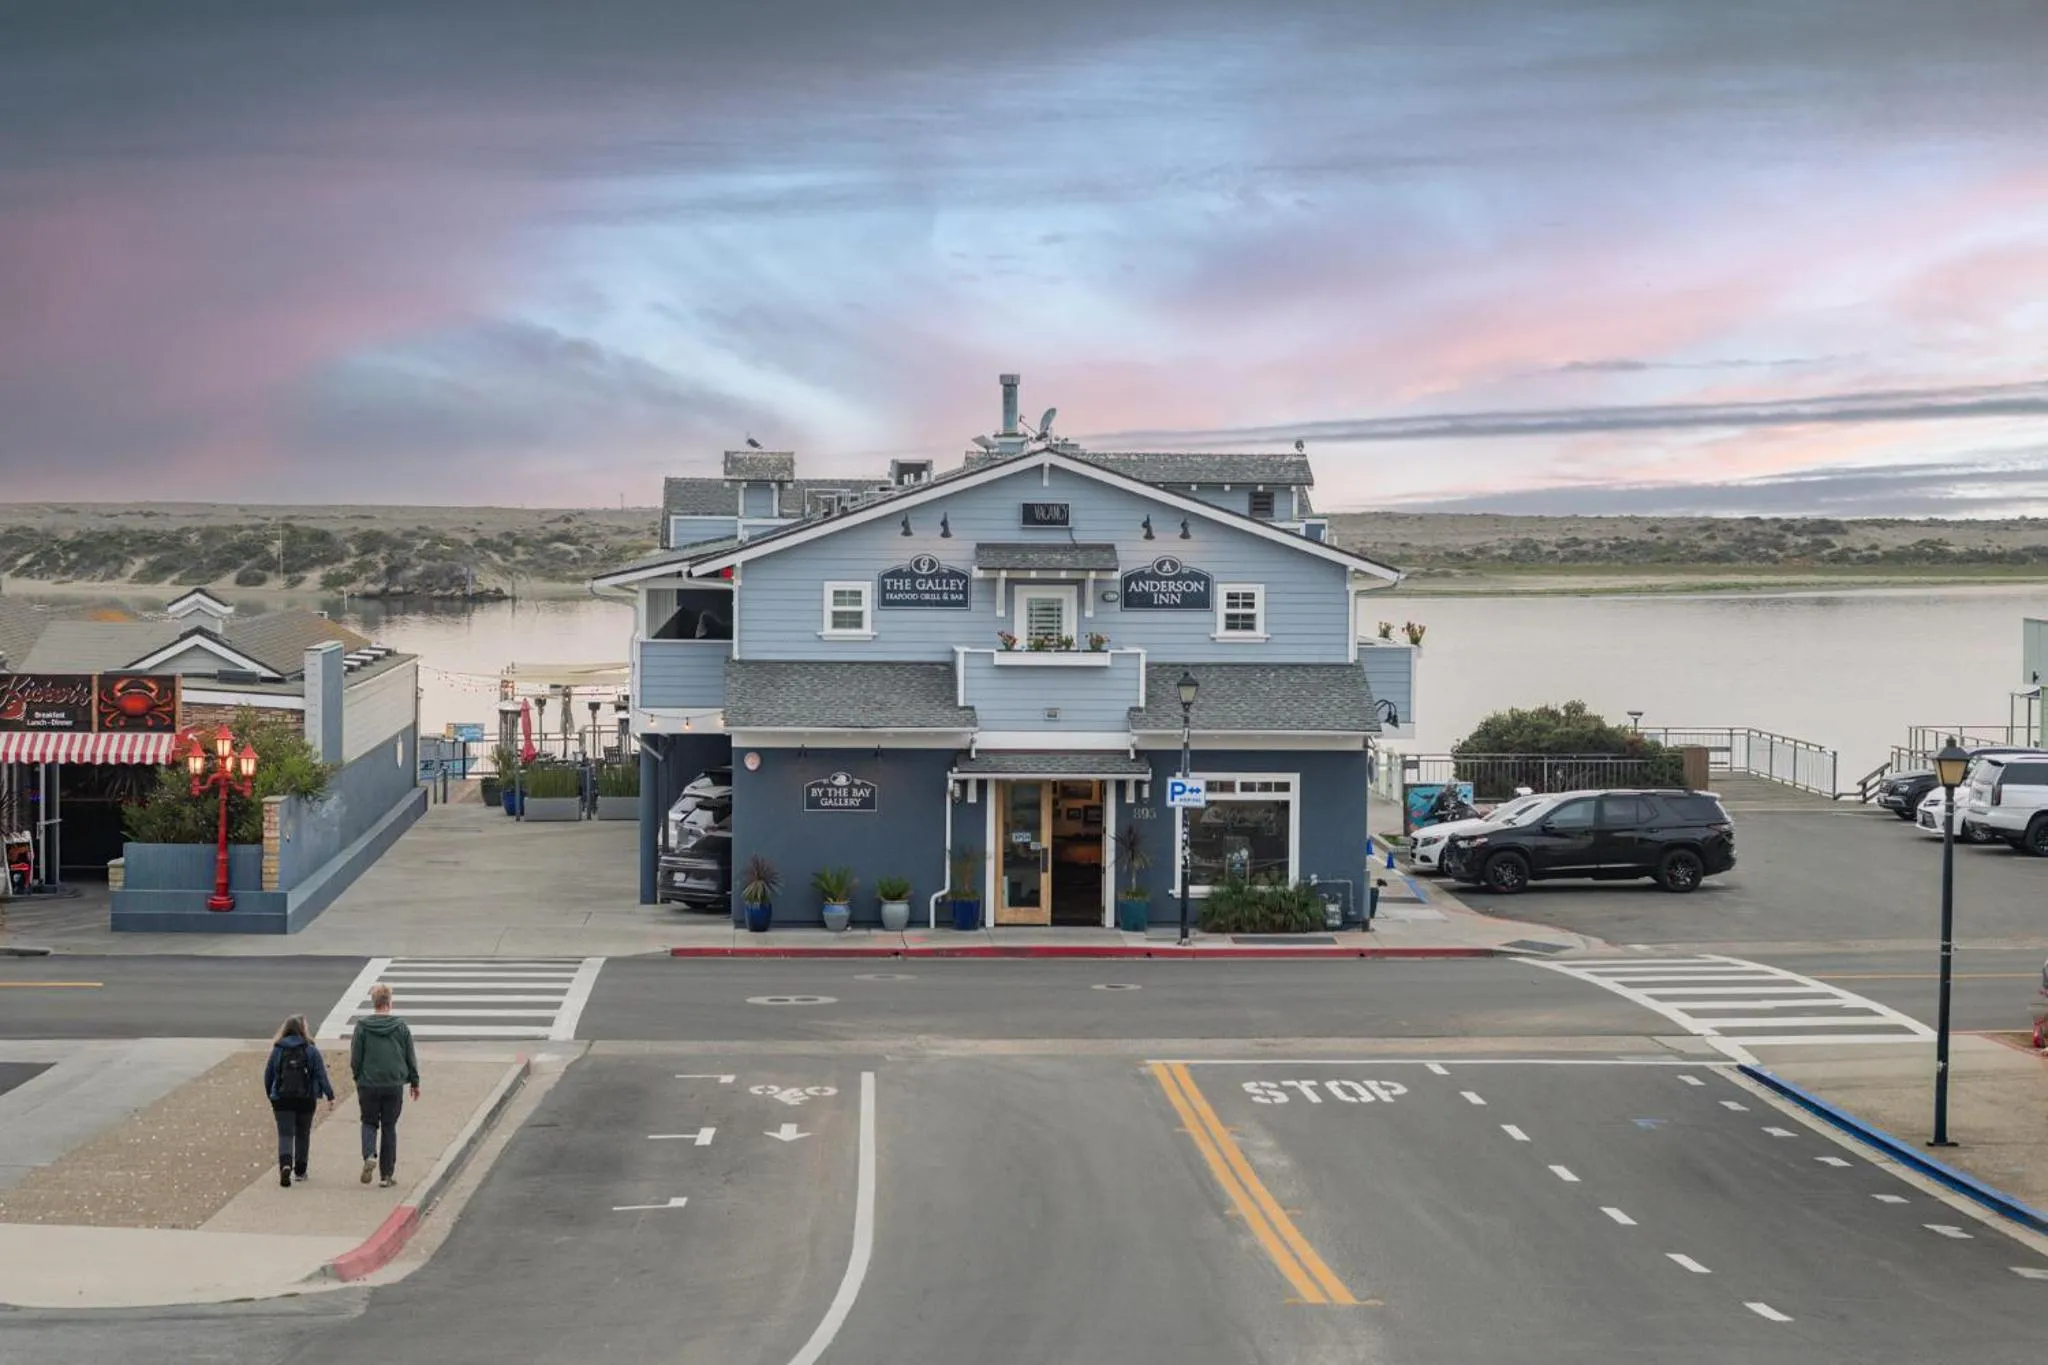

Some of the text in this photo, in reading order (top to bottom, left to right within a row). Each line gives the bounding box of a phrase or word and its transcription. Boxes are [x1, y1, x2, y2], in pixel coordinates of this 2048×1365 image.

[884, 579, 966, 590] THE GALLEY
[1128, 581, 1204, 592] ANDERSON
[1153, 593, 1181, 604] INN
[811, 788, 871, 797] BY THE BAY
[1241, 1080, 1408, 1104] STOP
